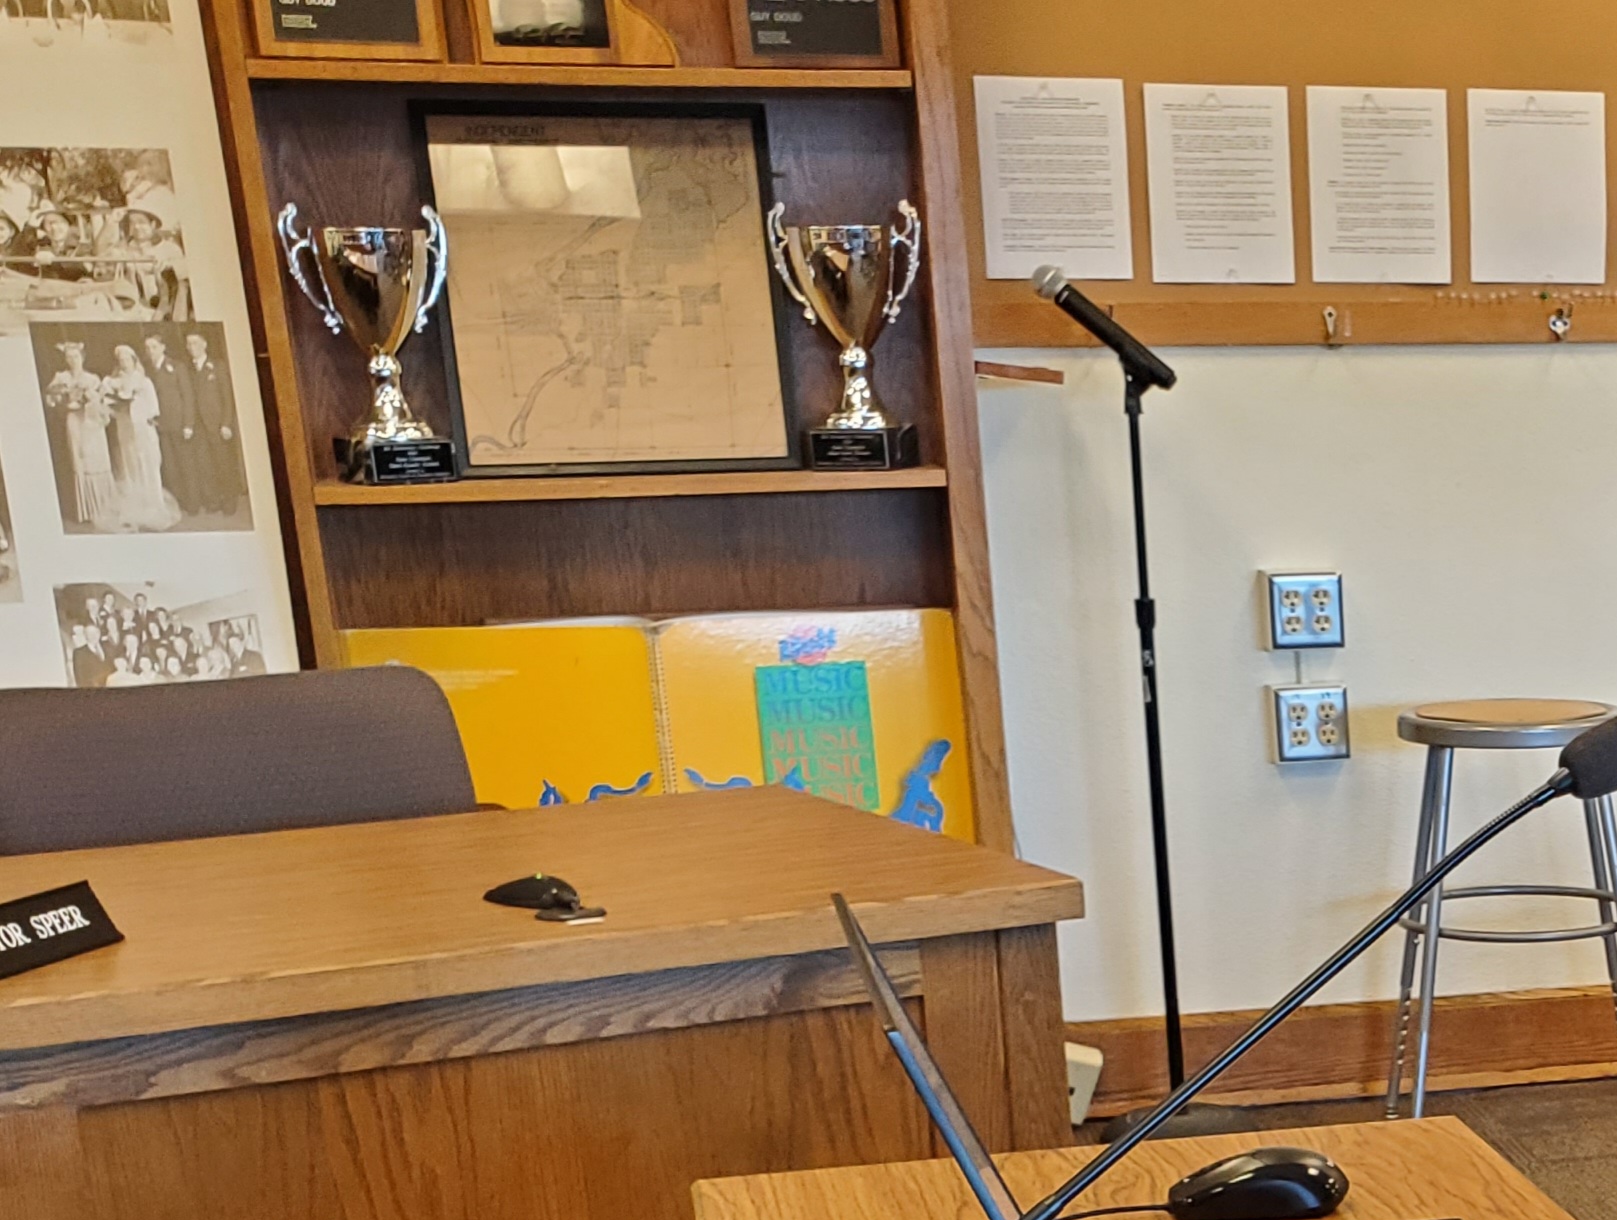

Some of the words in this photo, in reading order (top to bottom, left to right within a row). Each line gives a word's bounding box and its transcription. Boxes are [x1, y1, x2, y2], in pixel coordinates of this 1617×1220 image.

[765, 665, 864, 694] MUSIC
[767, 695, 866, 724] MUSIC
[770, 726, 869, 754] MUSIC
[29, 905, 91, 939] SPEER
